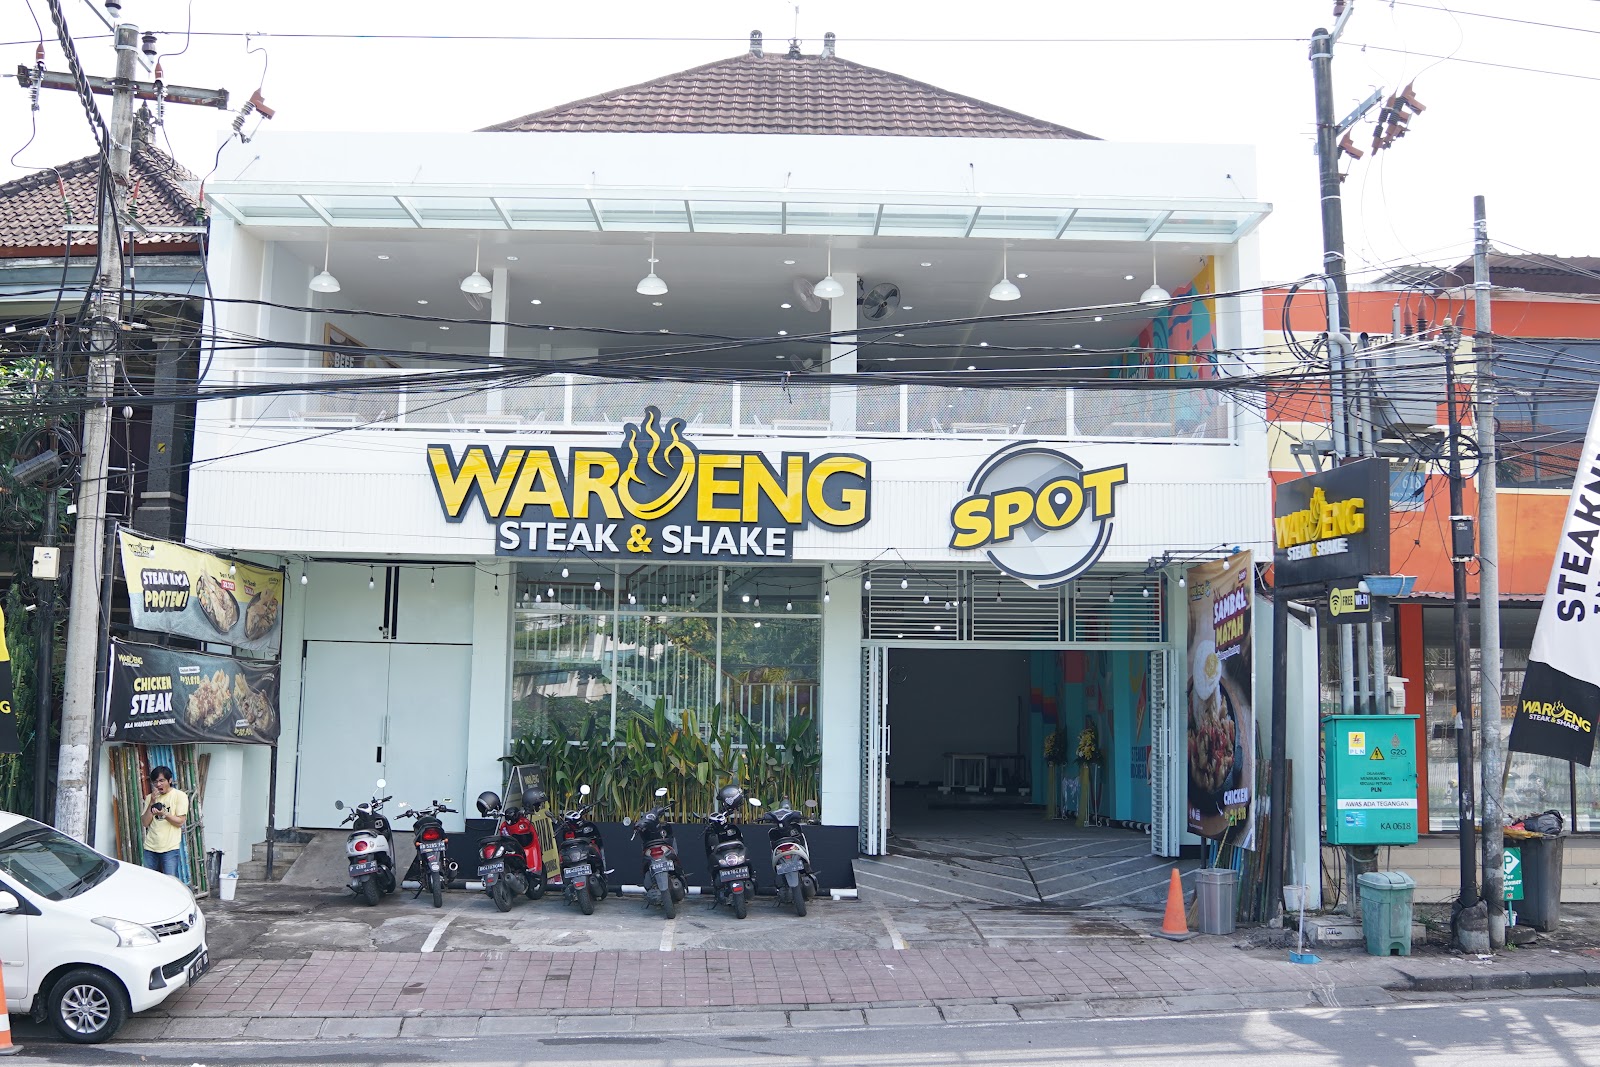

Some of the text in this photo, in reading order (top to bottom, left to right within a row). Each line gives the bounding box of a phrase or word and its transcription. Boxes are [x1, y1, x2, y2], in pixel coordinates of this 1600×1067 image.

[427, 410, 868, 527] WAROENG
[951, 465, 1127, 549] SPOT
[1275, 487, 1365, 548] WAROENG
[500, 521, 787, 557] STEAK & SHAKE
[1287, 546, 1311, 561] STEAK
[1316, 538, 1349, 557] SHAKE
[142, 571, 168, 585] STEAK
[1214, 587, 1247, 625] SAMBAL
[1342, 595, 1353, 606] FREE
[1216, 614, 1244, 648] MATAH
[133, 676, 172, 692] CHICKEN
[130, 692, 173, 716] STEAK
[1522, 700, 1592, 733] WAROENG
[1529, 714, 1551, 723] STEAK
[1556, 719, 1580, 732] SHAKE
[1224, 787, 1248, 806] CHICKEN
[1380, 822, 1412, 830] KA 0618
